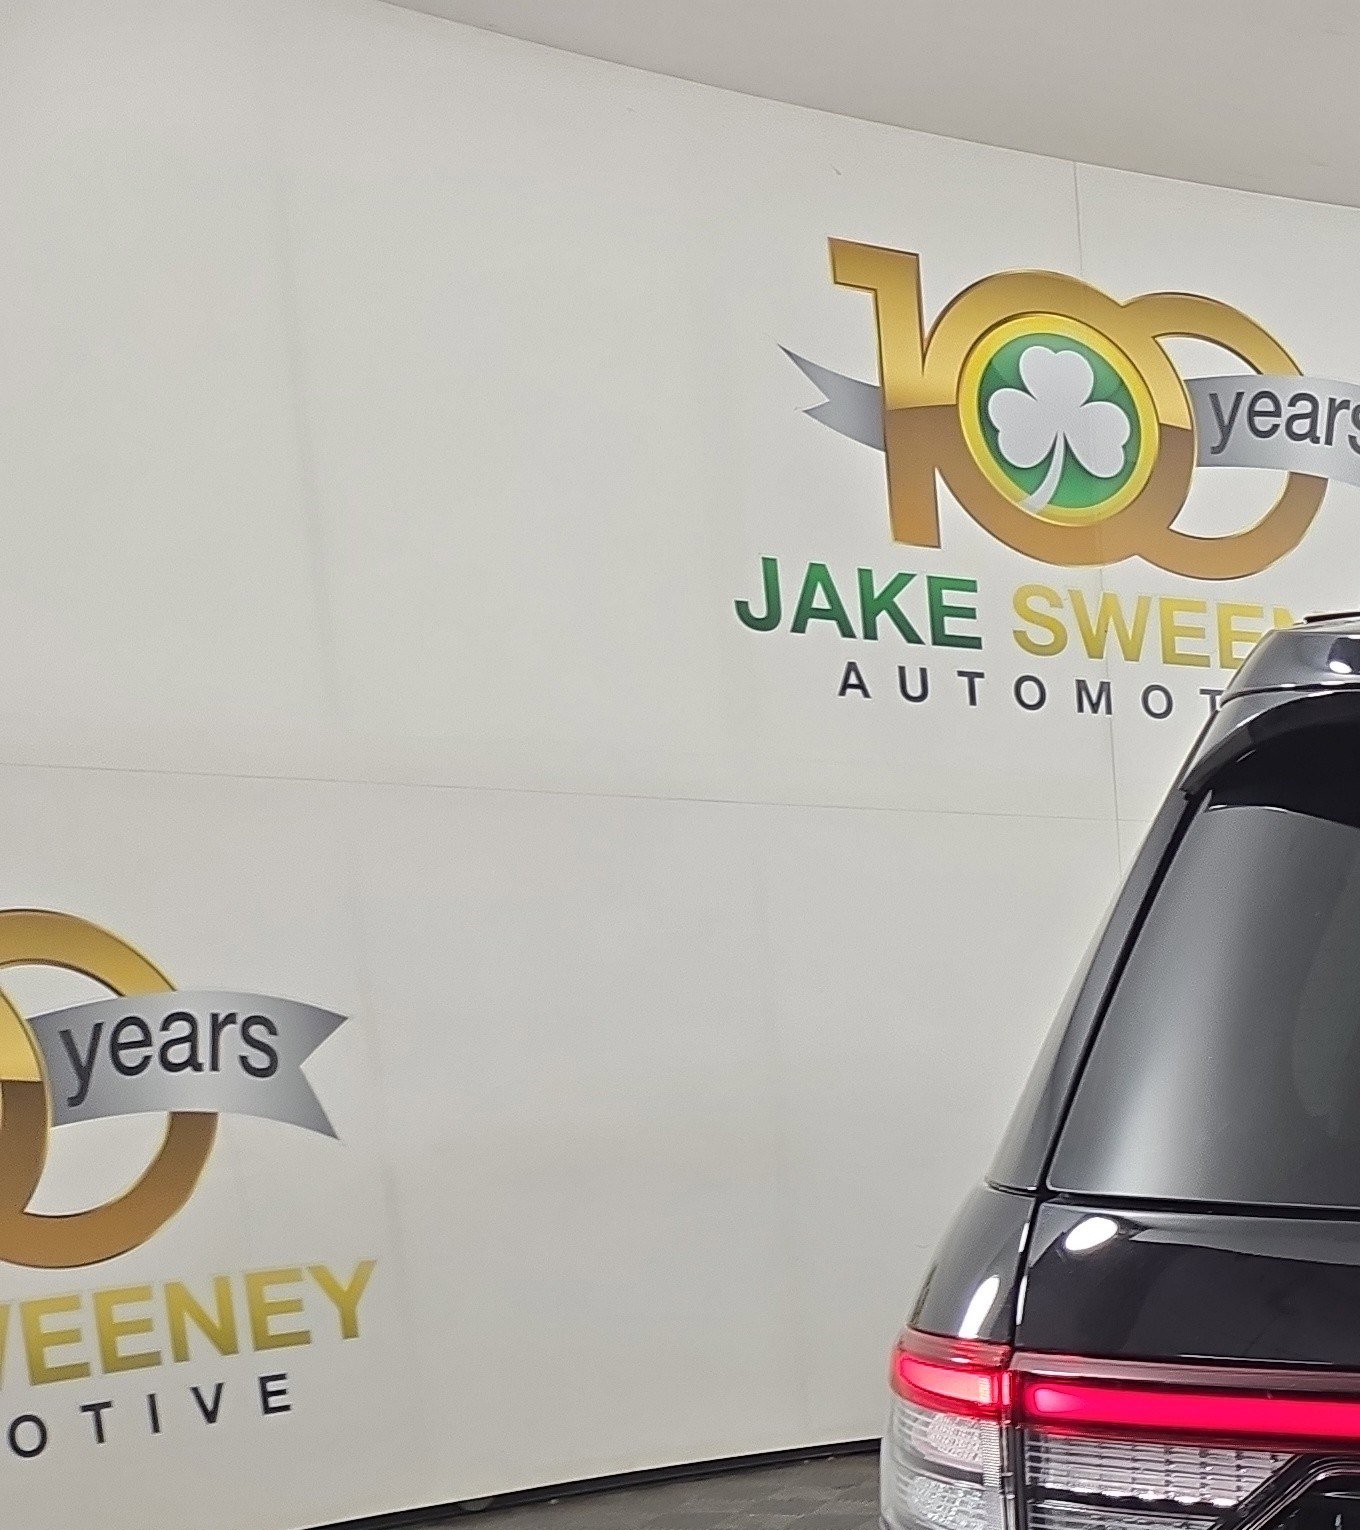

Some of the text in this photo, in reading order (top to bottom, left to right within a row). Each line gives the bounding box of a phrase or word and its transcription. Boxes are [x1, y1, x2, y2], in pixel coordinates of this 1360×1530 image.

[828, 237, 1328, 580] 100
[733, 556, 984, 651] JAKE
[58, 1009, 281, 1108] years
[0, 1258, 378, 1390] EENEY
[8, 1371, 293, 1459] OTIVE
